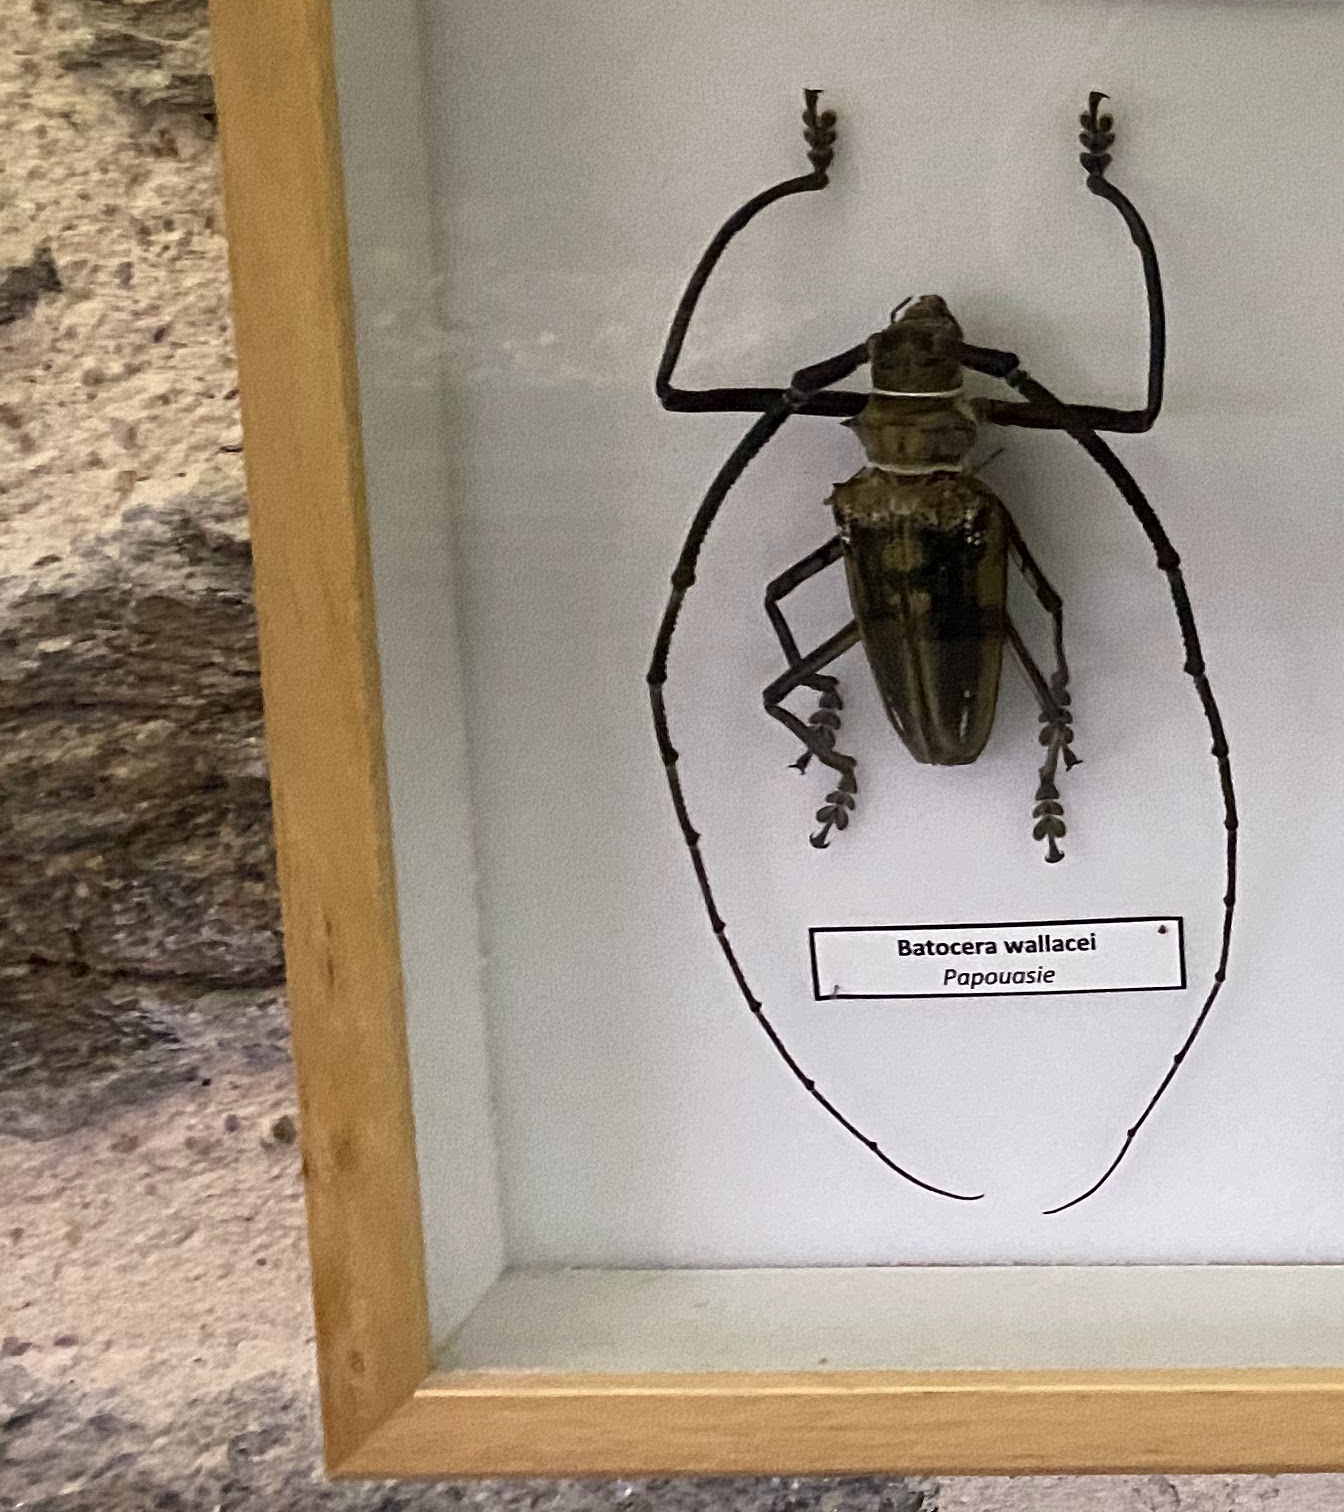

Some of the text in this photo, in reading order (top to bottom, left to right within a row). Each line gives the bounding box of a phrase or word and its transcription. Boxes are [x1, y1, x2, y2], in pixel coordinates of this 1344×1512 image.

[897, 933, 1096, 956] Batocera wallacei
[943, 967, 1056, 989] Papouasie
